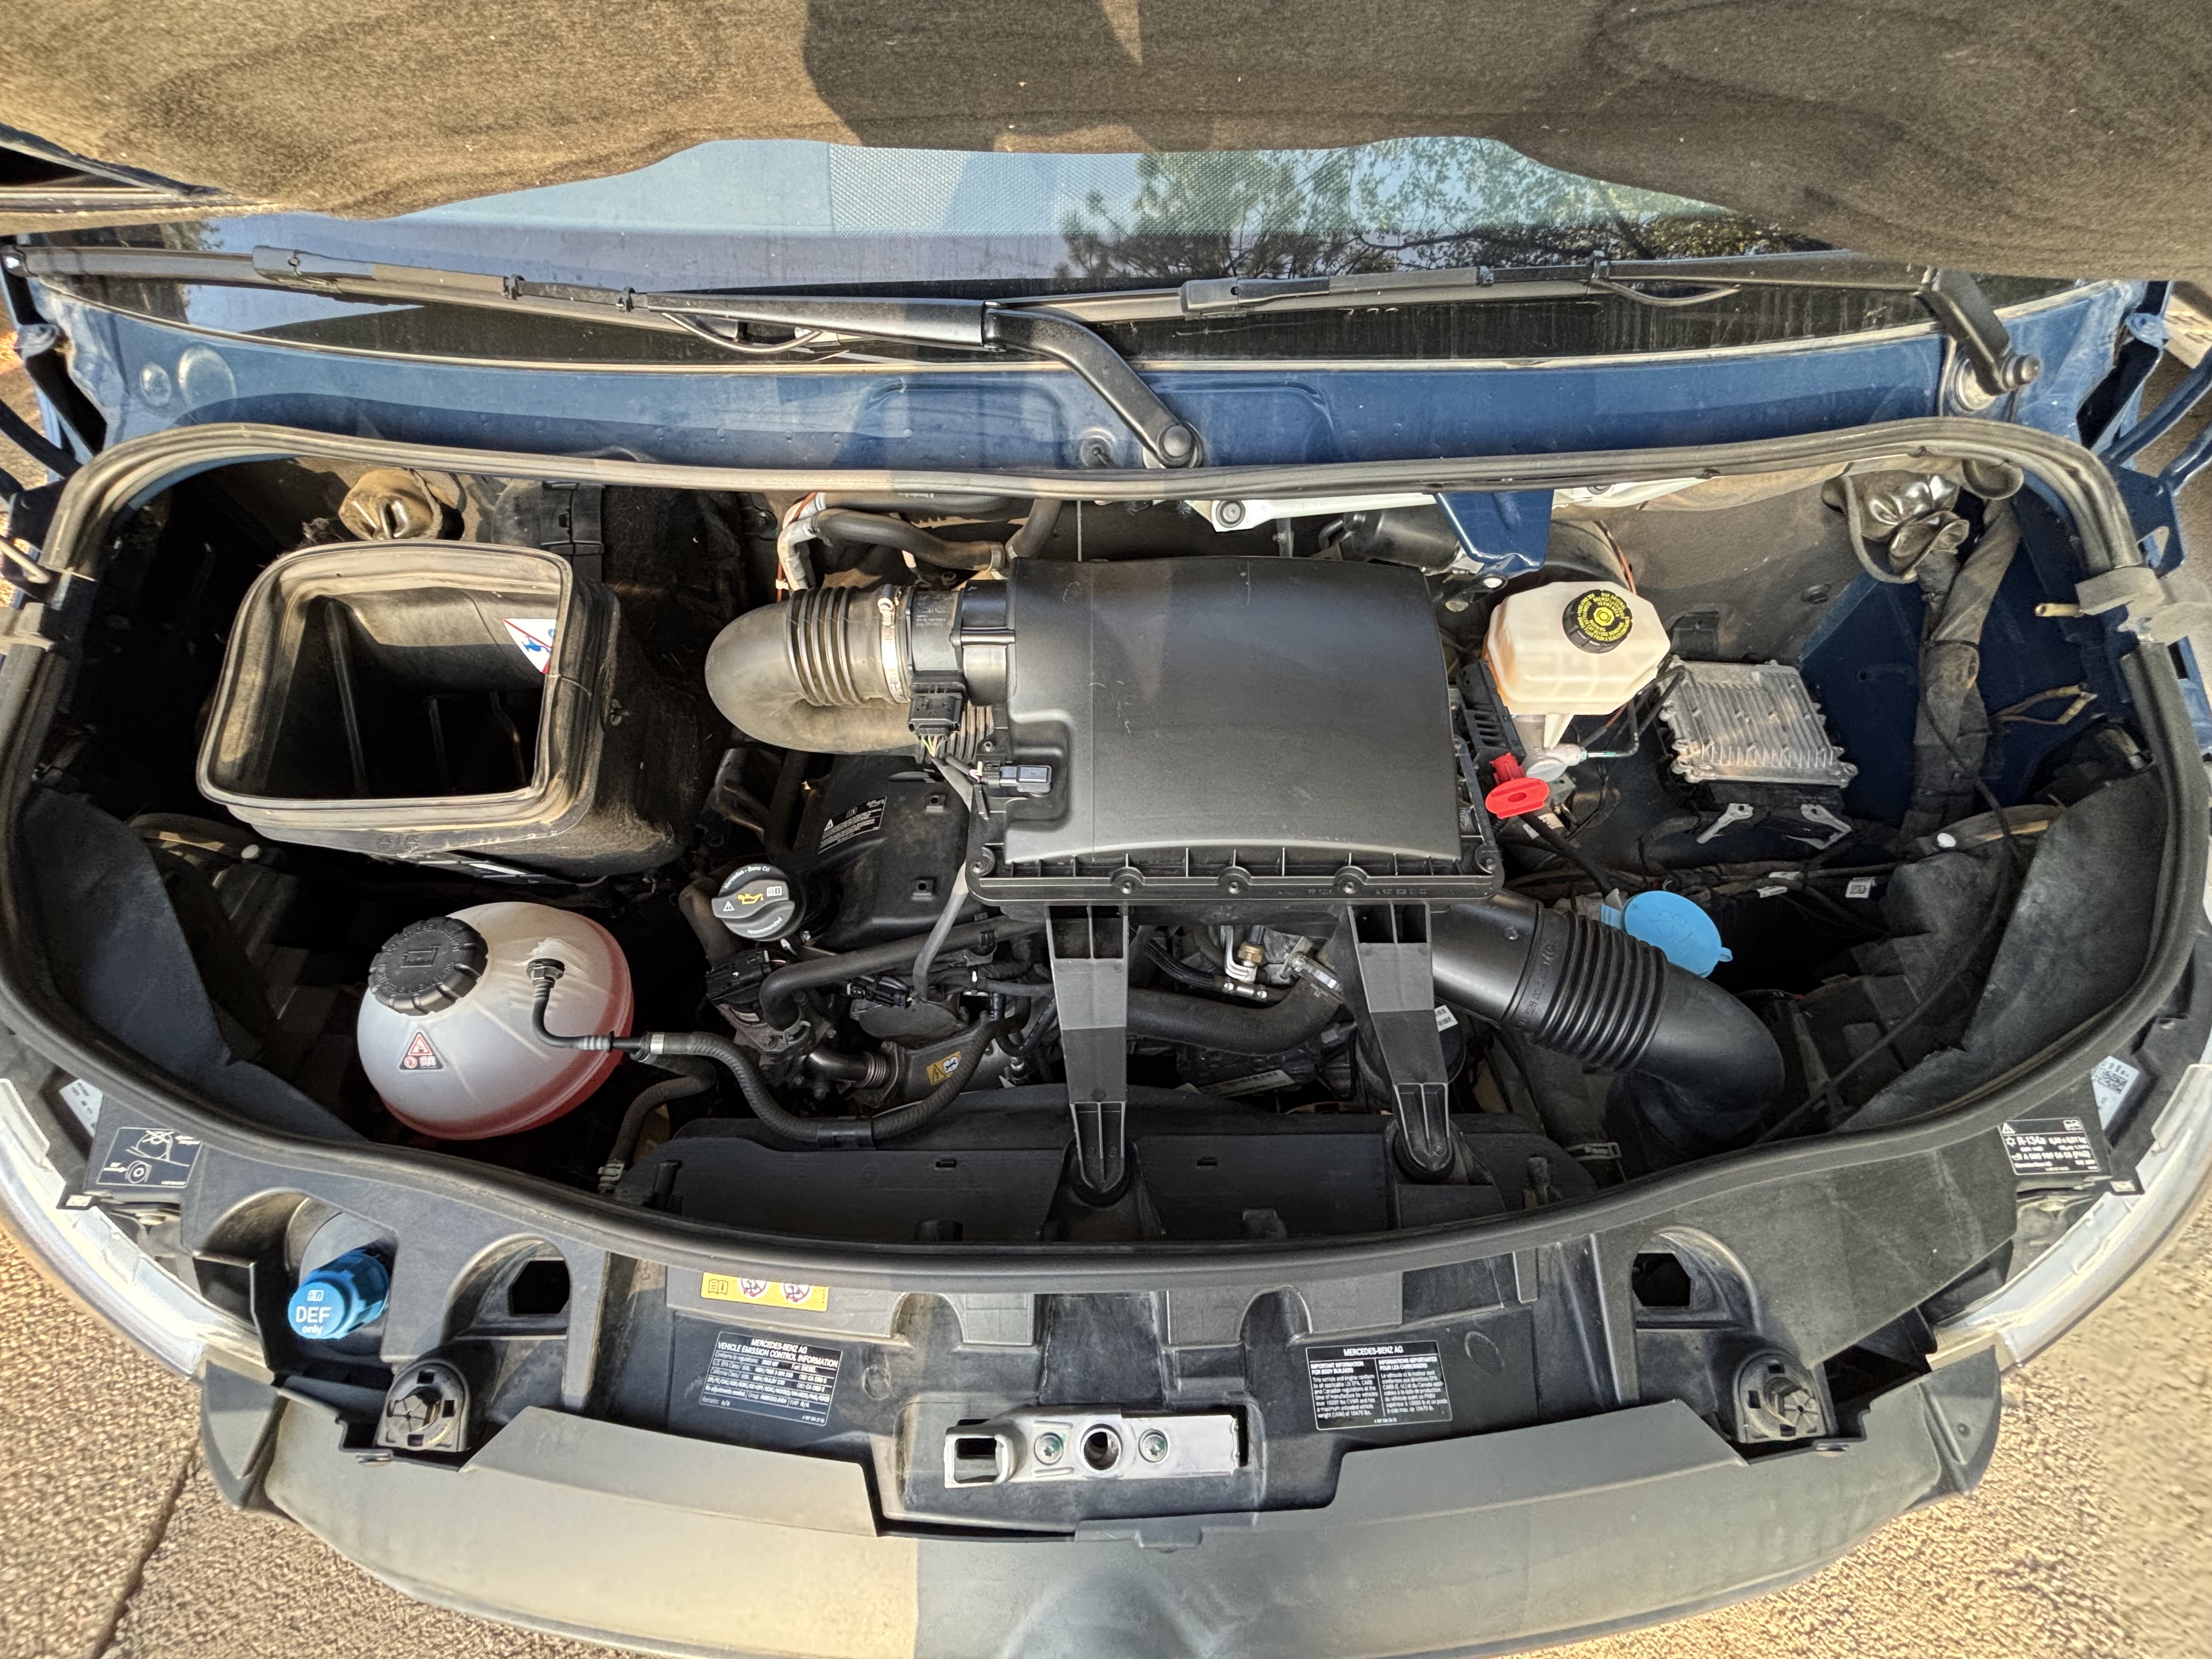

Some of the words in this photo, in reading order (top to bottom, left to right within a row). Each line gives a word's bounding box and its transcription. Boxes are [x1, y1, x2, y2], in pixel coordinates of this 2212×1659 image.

[724, 870, 744, 889] Mercedes
[747, 916, 783, 934] recommended
[2017, 1136, 2047, 1146] R-134a
[296, 1306, 331, 1323] DEF
[302, 1324, 323, 1336] only
[751, 1339, 798, 1353] MERCEDES-BENZ
[1343, 1346, 1393, 1357] MERCEDES-BENZ
[1394, 1345, 1403, 1353] AG
[718, 1342, 741, 1352] VEHICLE
[741, 1345, 769, 1356] EMISSION
[770, 1350, 797, 1361] CONTROL
[798, 1354, 838, 1368] INFORMATION
